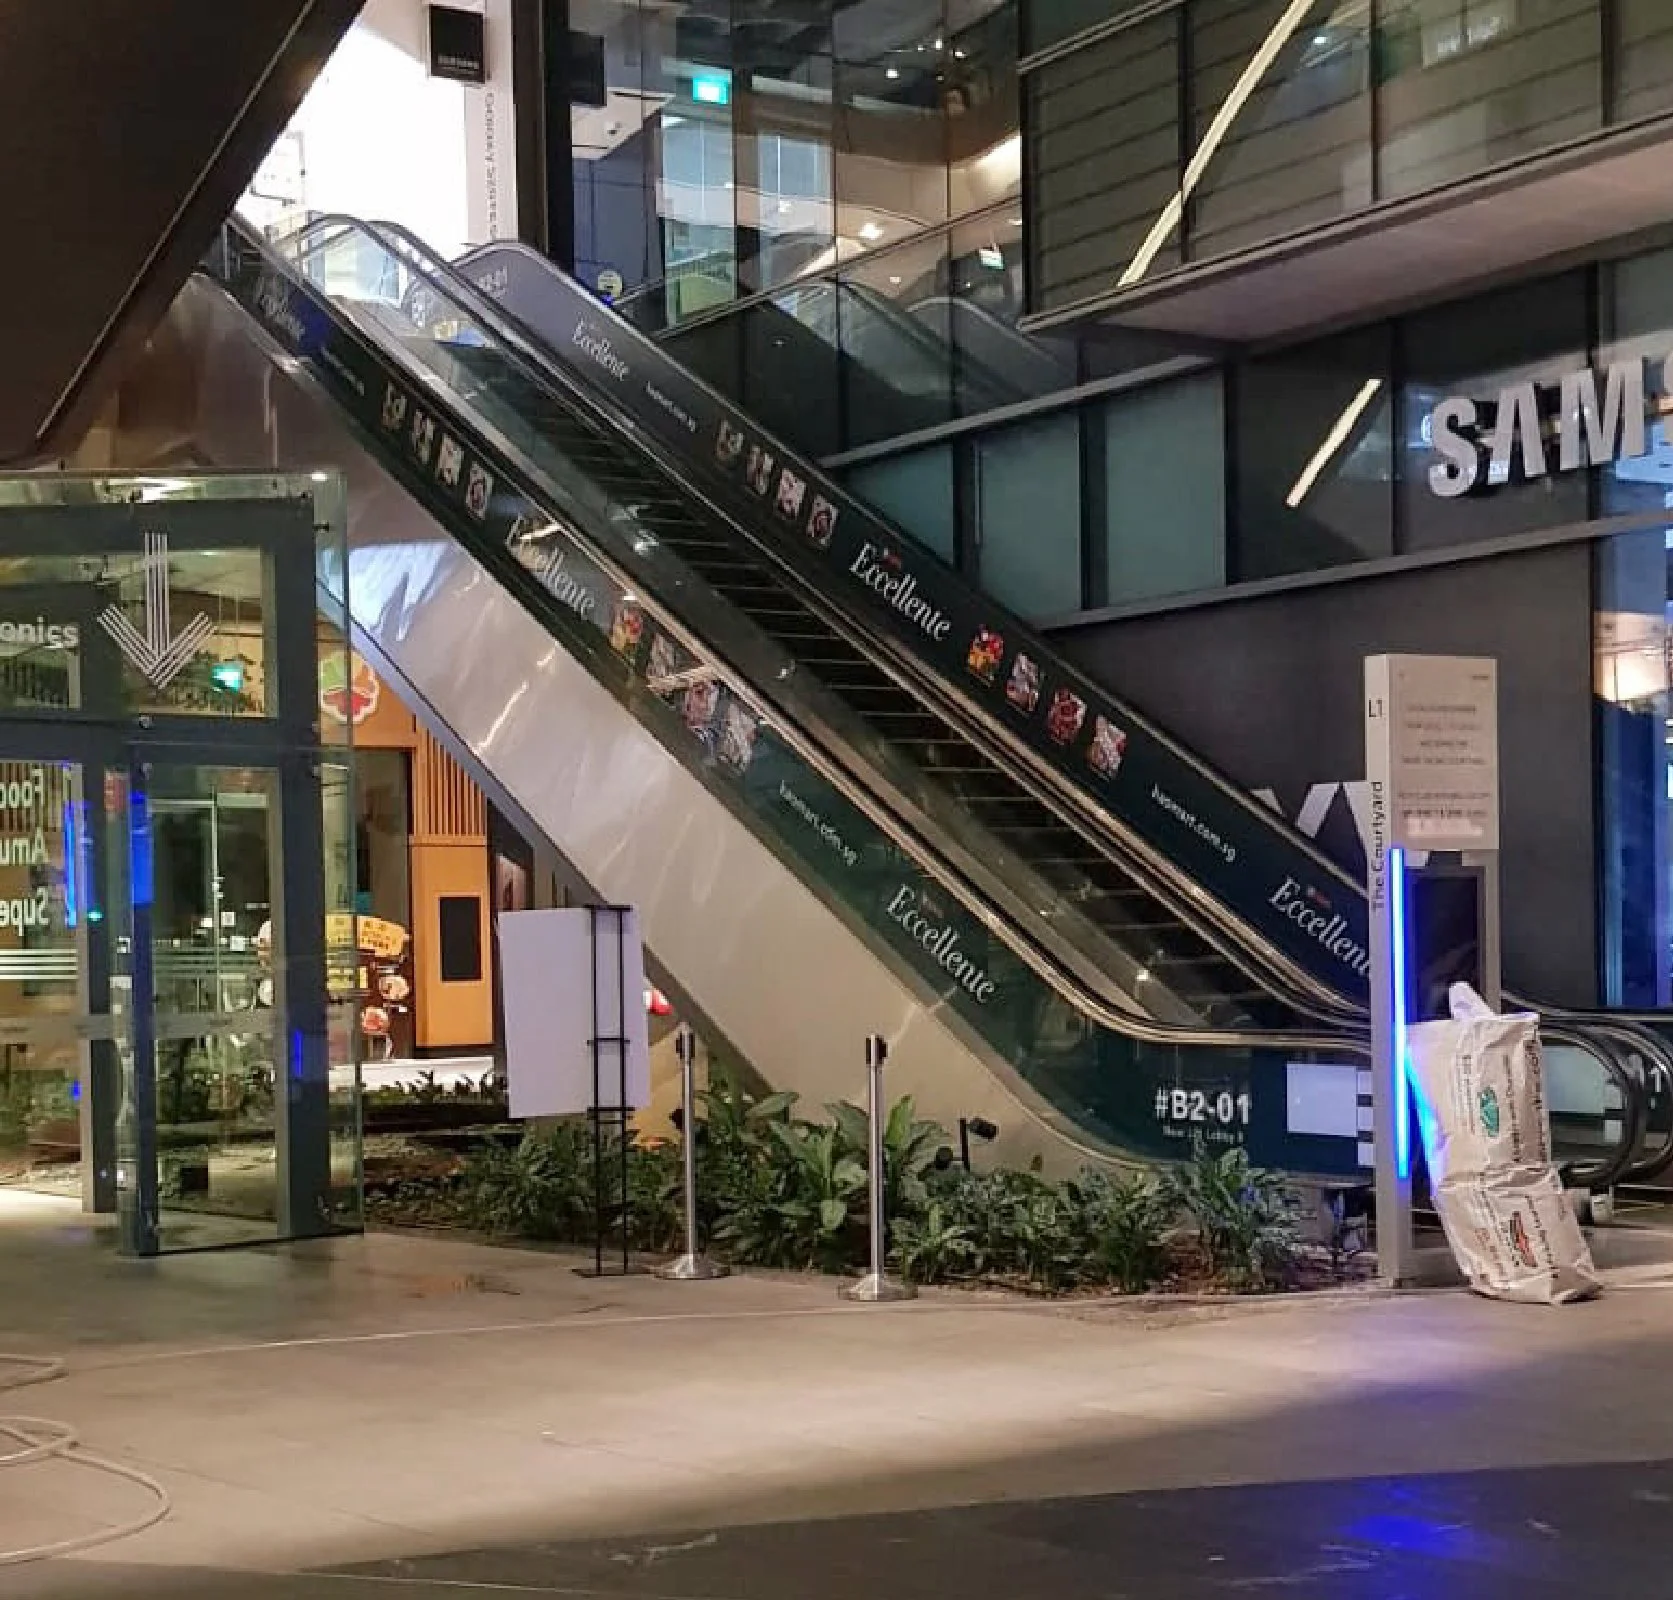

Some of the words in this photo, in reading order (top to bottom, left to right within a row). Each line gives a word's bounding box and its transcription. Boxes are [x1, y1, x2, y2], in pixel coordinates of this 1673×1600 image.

[1429, 354, 1673, 497] SAM
[849, 540, 952, 642] Eccellente
[1371, 781, 1386, 873] Courtyard
[887, 883, 996, 1005] Eccellente
[1154, 1087, 1249, 1124] #B2-01
